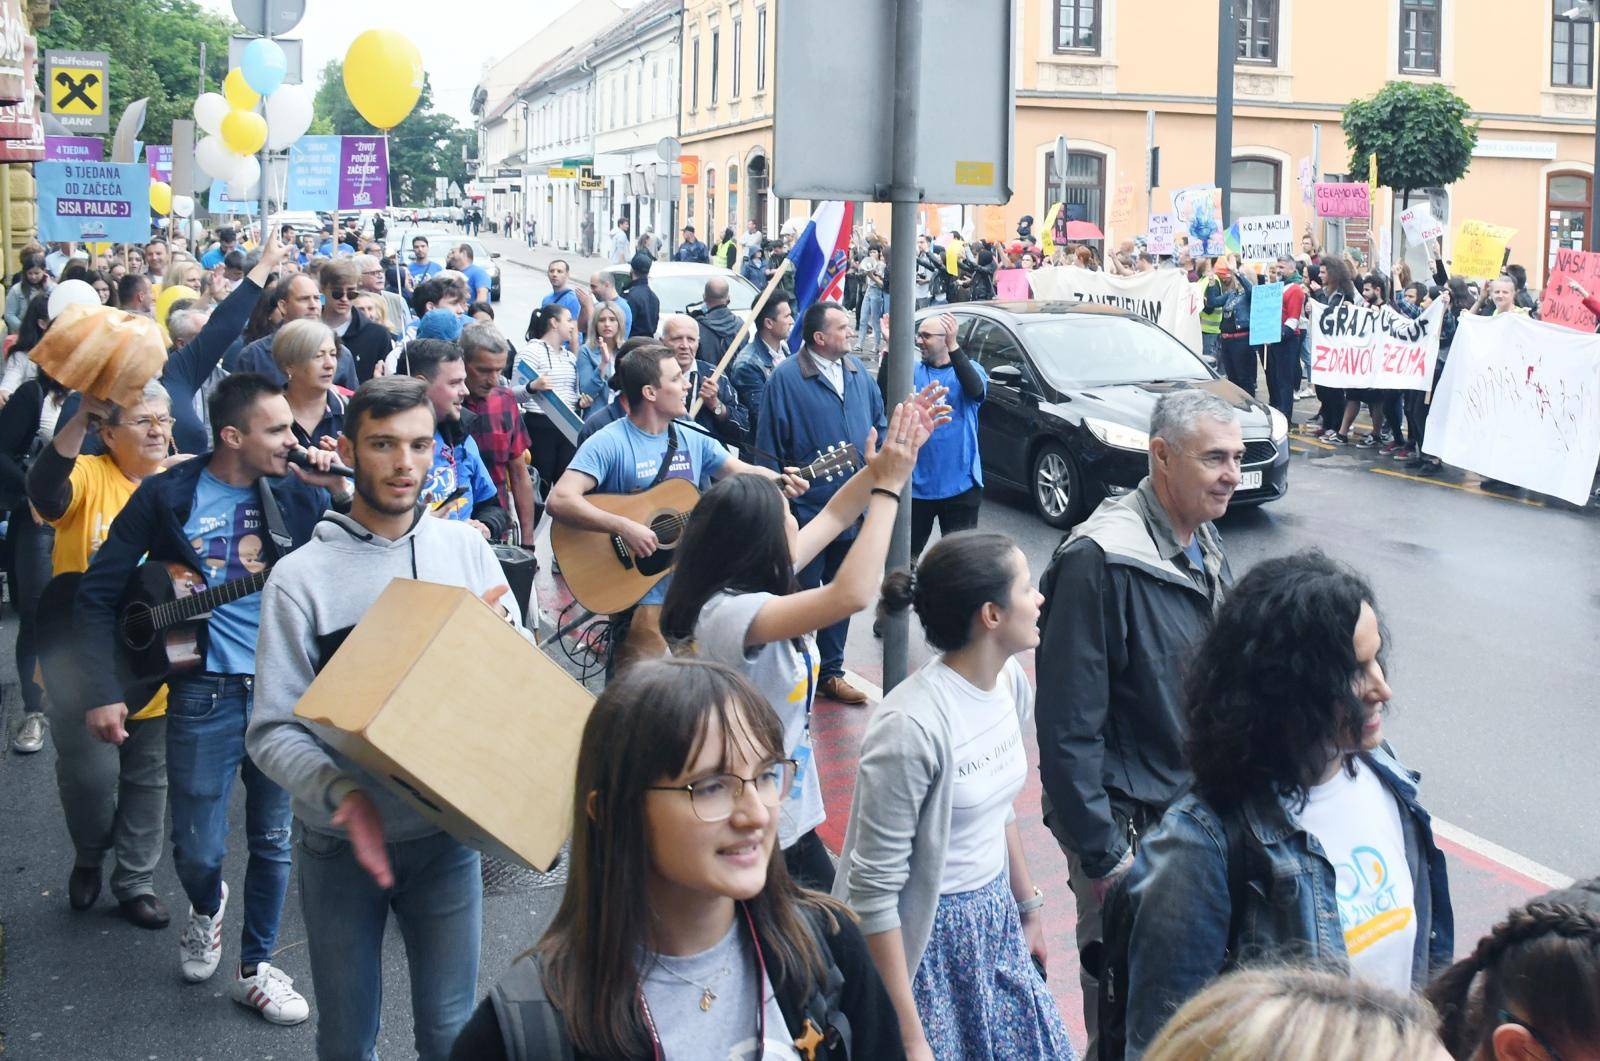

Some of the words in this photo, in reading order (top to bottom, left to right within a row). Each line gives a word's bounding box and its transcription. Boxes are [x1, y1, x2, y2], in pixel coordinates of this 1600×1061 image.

[51, 56, 103, 67] Raiffeisen
[60, 118, 93, 126] BANK
[56, 145, 61, 154] 4
[63, 145, 89, 155] TJEDNA
[65, 166, 72, 178] 9
[75, 166, 121, 179] TJEDANA
[65, 182, 79, 195] OD
[83, 182, 122, 196] ZAČEĆA
[58, 201, 82, 214] SISA
[84, 202, 118, 215] PALAC
[120, 203, 129, 216] :)
[1242, 222, 1263, 232] KOJA
[1266, 220, 1290, 230] NACIJA
